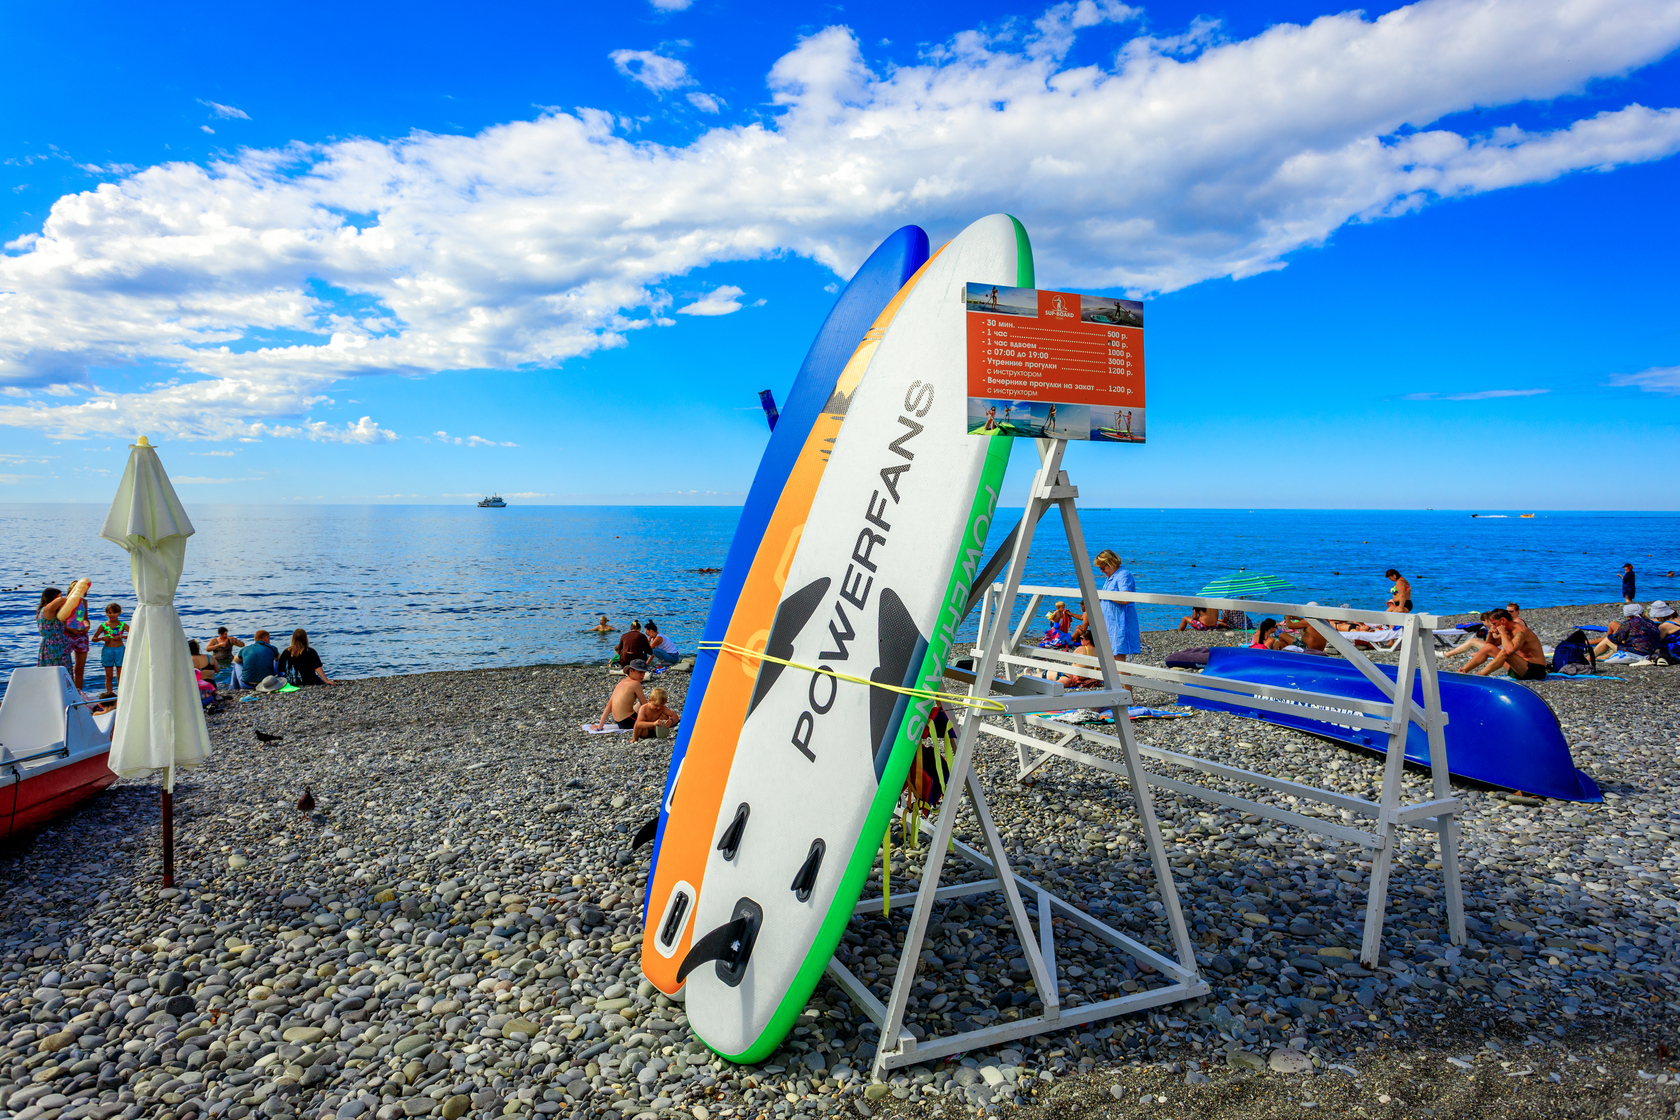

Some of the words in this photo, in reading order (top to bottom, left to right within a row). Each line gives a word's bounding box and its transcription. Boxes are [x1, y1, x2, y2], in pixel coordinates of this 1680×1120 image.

[1045, 310, 1074, 318] SUP-BOARD
[987, 319, 996, 327] 30
[987, 358, 1022, 366] Утренние
[1025, 362, 1057, 370] прогулки
[994, 369, 1042, 378] инструктором
[1030, 381, 1061, 389] прогулки
[791, 379, 935, 763] POWERFANS
